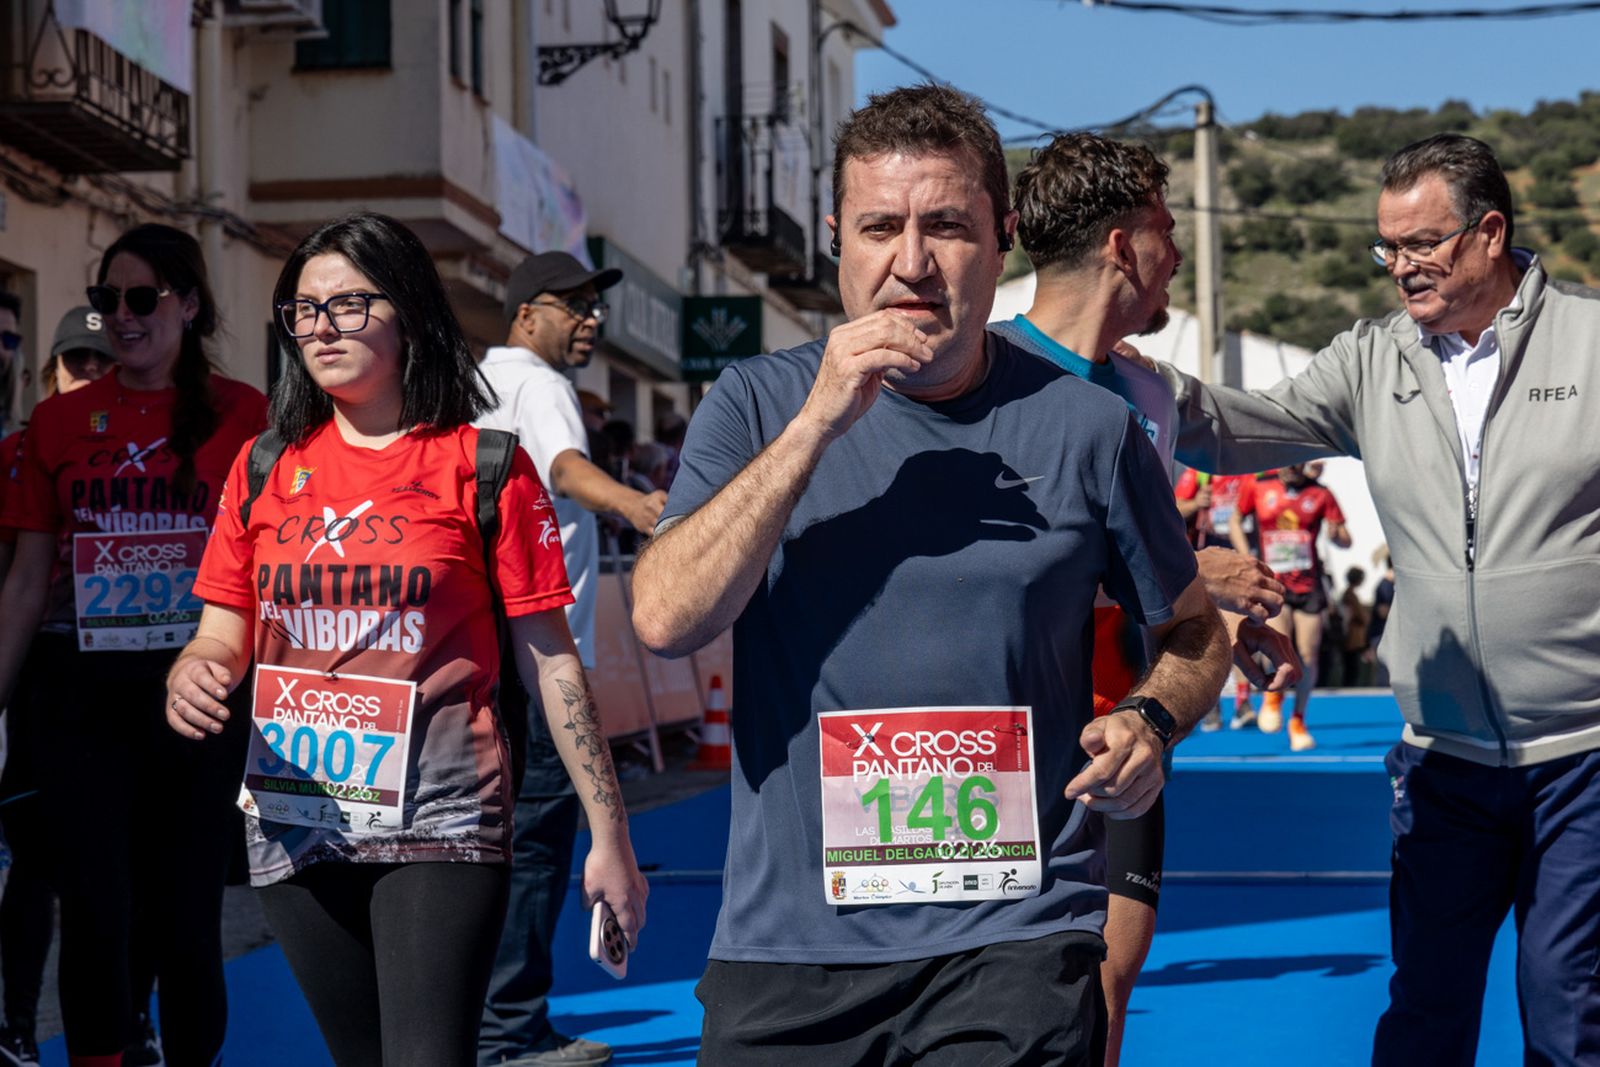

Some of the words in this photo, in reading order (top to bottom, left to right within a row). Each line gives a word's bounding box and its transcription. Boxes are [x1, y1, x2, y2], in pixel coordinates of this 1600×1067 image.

[86, 312, 102, 331] S
[1528, 385, 1578, 402] RFEA
[276, 514, 409, 545] CROSS
[95, 540, 115, 562] X
[117, 543, 188, 562] CROSS
[94, 560, 172, 578] PANTANO
[84, 570, 205, 615] 2292
[257, 563, 432, 607] PANTANO
[281, 599, 424, 654] VÍBORAS
[275, 677, 299, 707] X
[301, 689, 381, 717] CROSS
[273, 707, 361, 733] PANTANO
[851, 722, 884, 757] X
[890, 730, 997, 757] CROSS
[257, 722, 396, 787] 3007
[852, 756, 974, 782] PANTANO
[977, 762, 997, 773] DEL
[861, 775, 1000, 843] 146
[855, 826, 876, 837] LAS
[826, 848, 882, 863] MIGUEL
[885, 846, 955, 862] DELGADO
